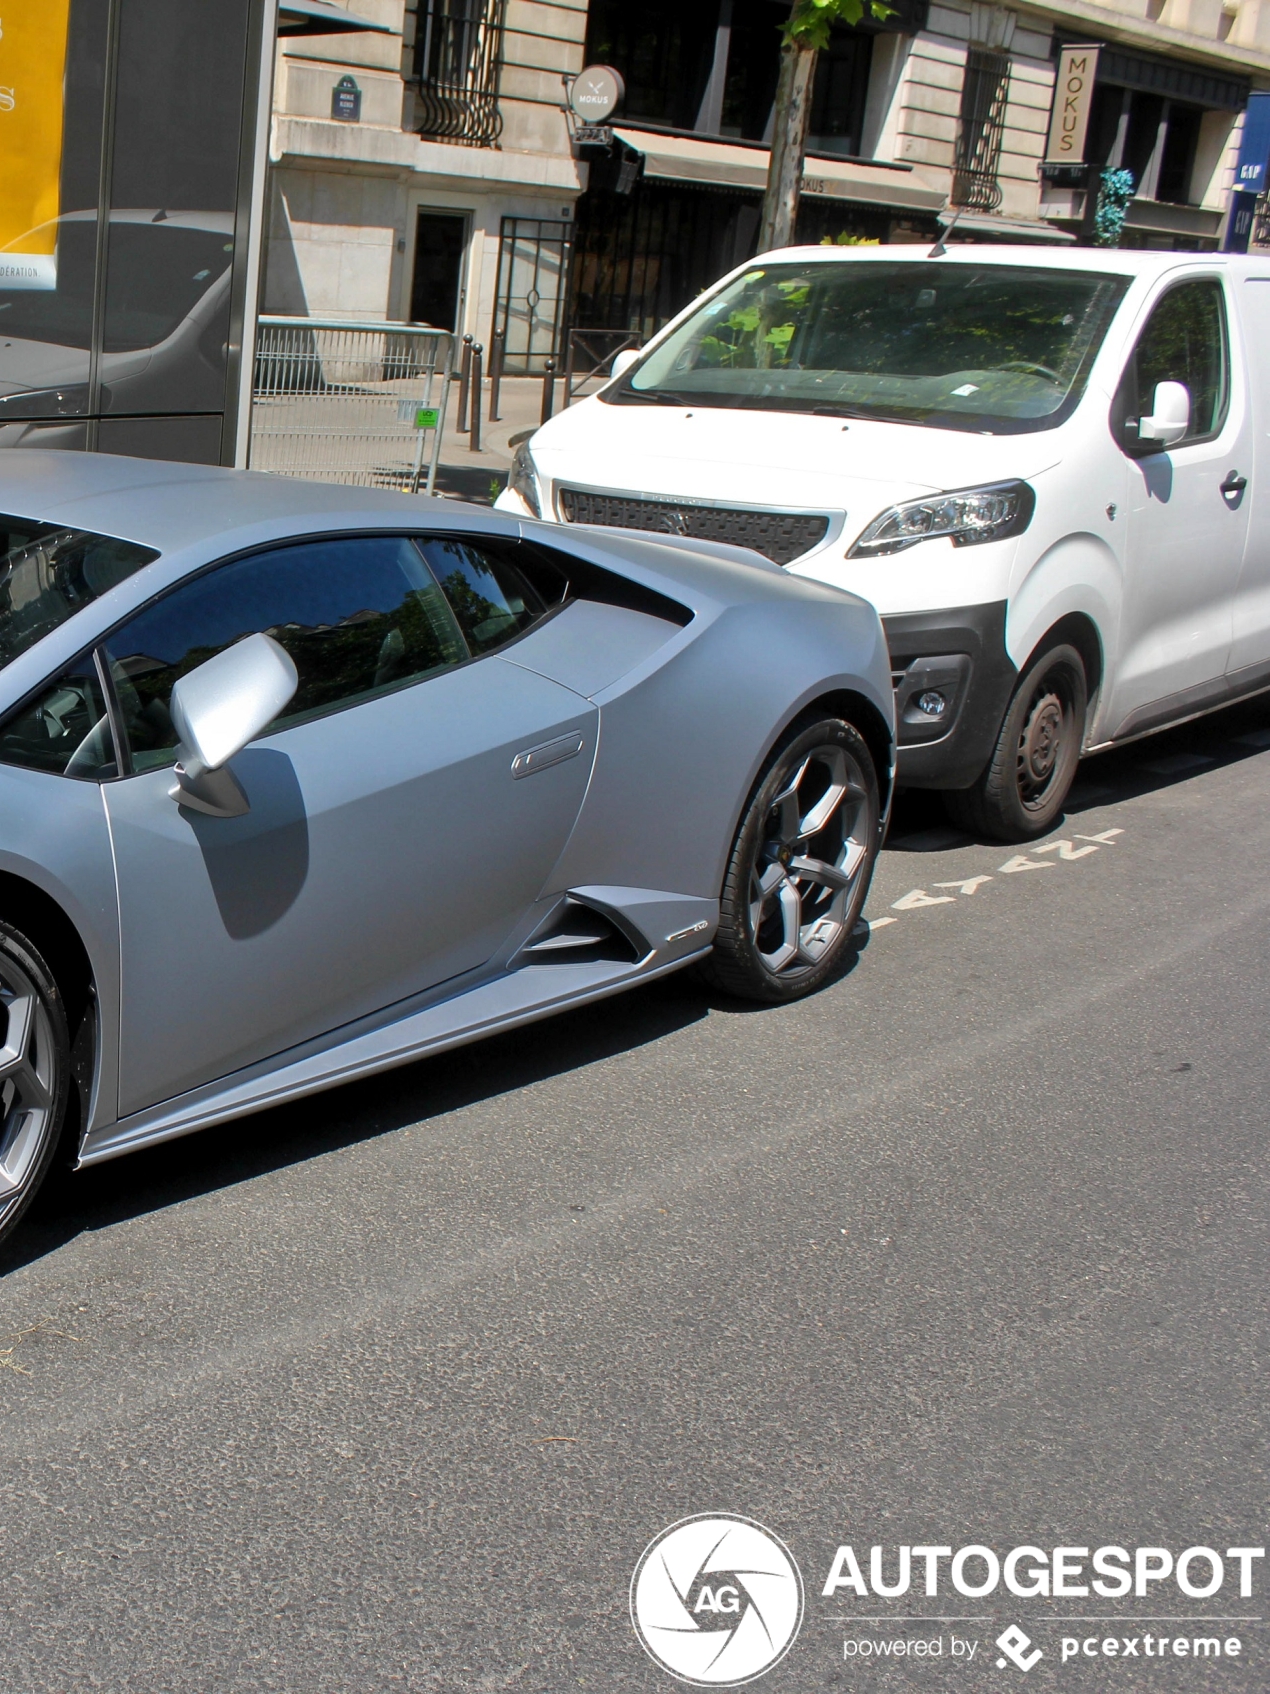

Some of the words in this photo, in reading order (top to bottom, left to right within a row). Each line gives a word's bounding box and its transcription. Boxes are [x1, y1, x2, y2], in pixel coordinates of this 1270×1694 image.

[579, 95, 609, 104] MOKUS
[1060, 57, 1087, 151] MOKUS
[1240, 164, 1262, 179] GAP
[800, 178, 824, 193] OKUS
[852, 827, 1126, 936] AYANT
